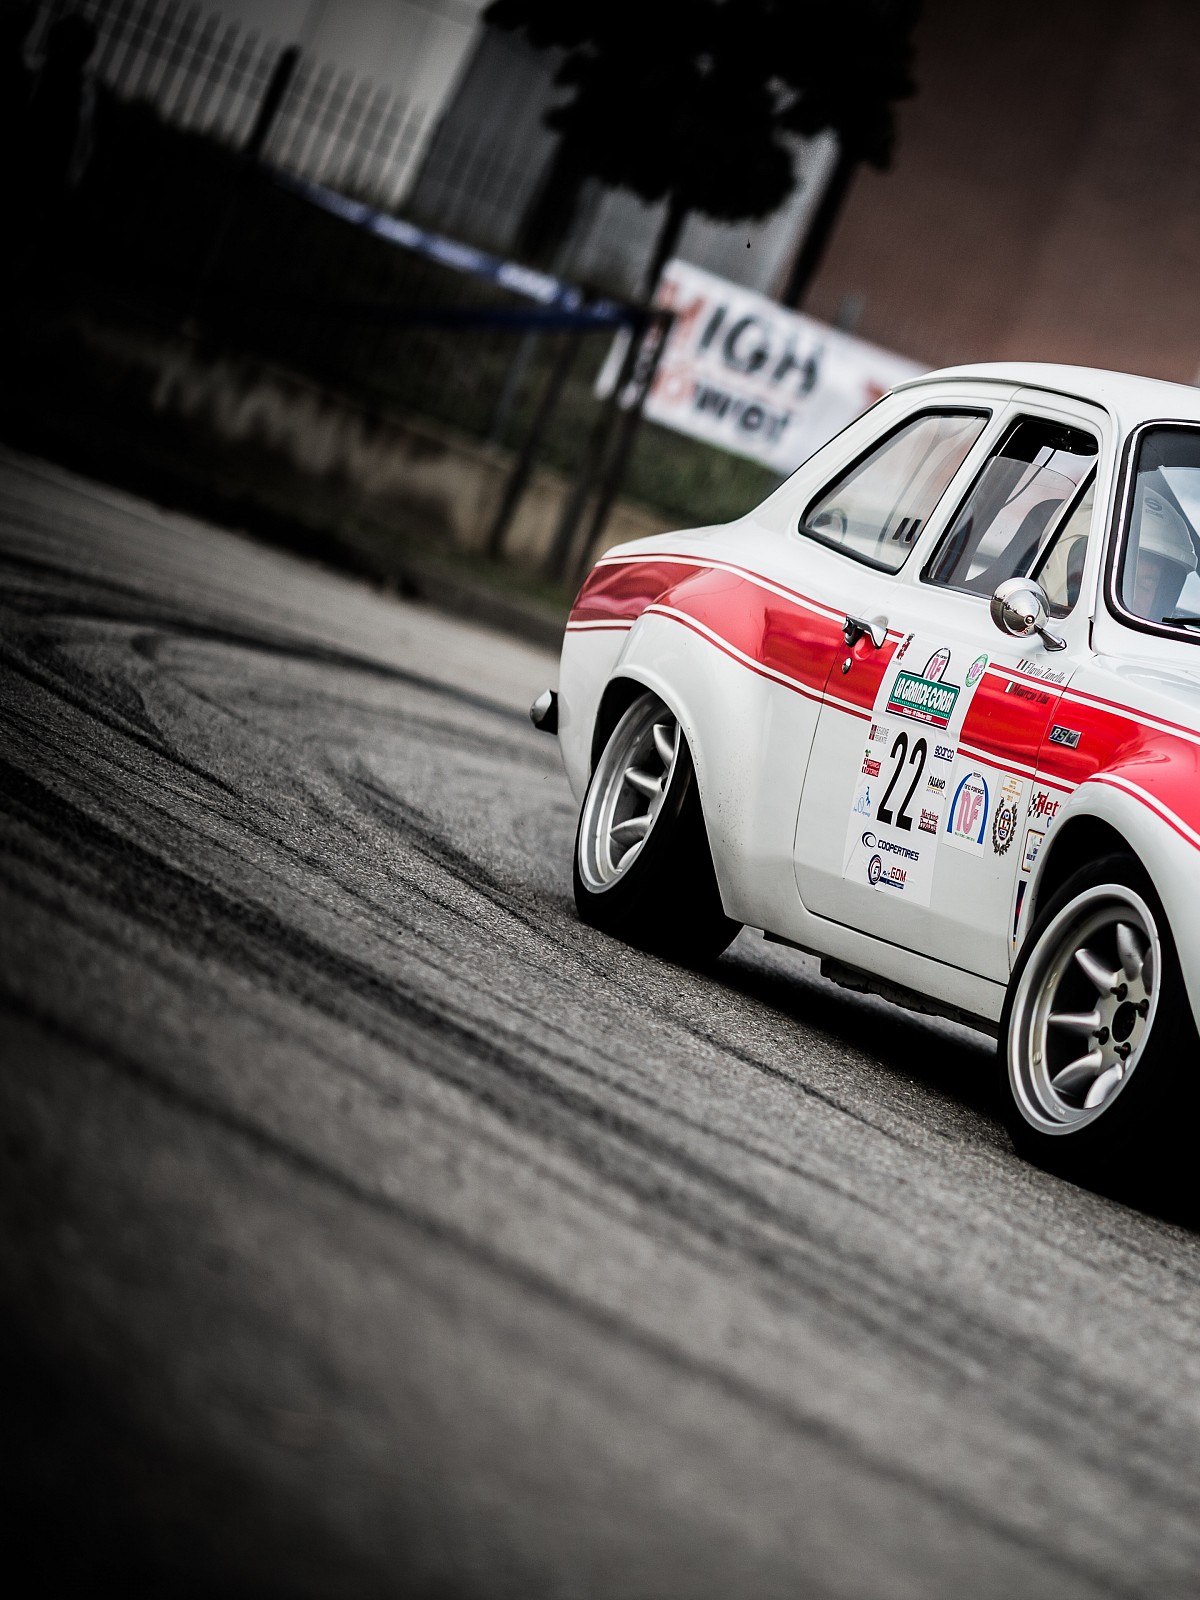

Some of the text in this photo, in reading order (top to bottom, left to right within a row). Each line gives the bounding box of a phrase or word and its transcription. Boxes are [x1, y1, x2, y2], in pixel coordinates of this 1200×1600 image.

[901, 679, 933, 706] GRANDE
[927, 687, 955, 712] CORSA
[934, 745, 955, 759] sparco
[876, 731, 928, 832] 22
[1036, 794, 1061, 817] Ret
